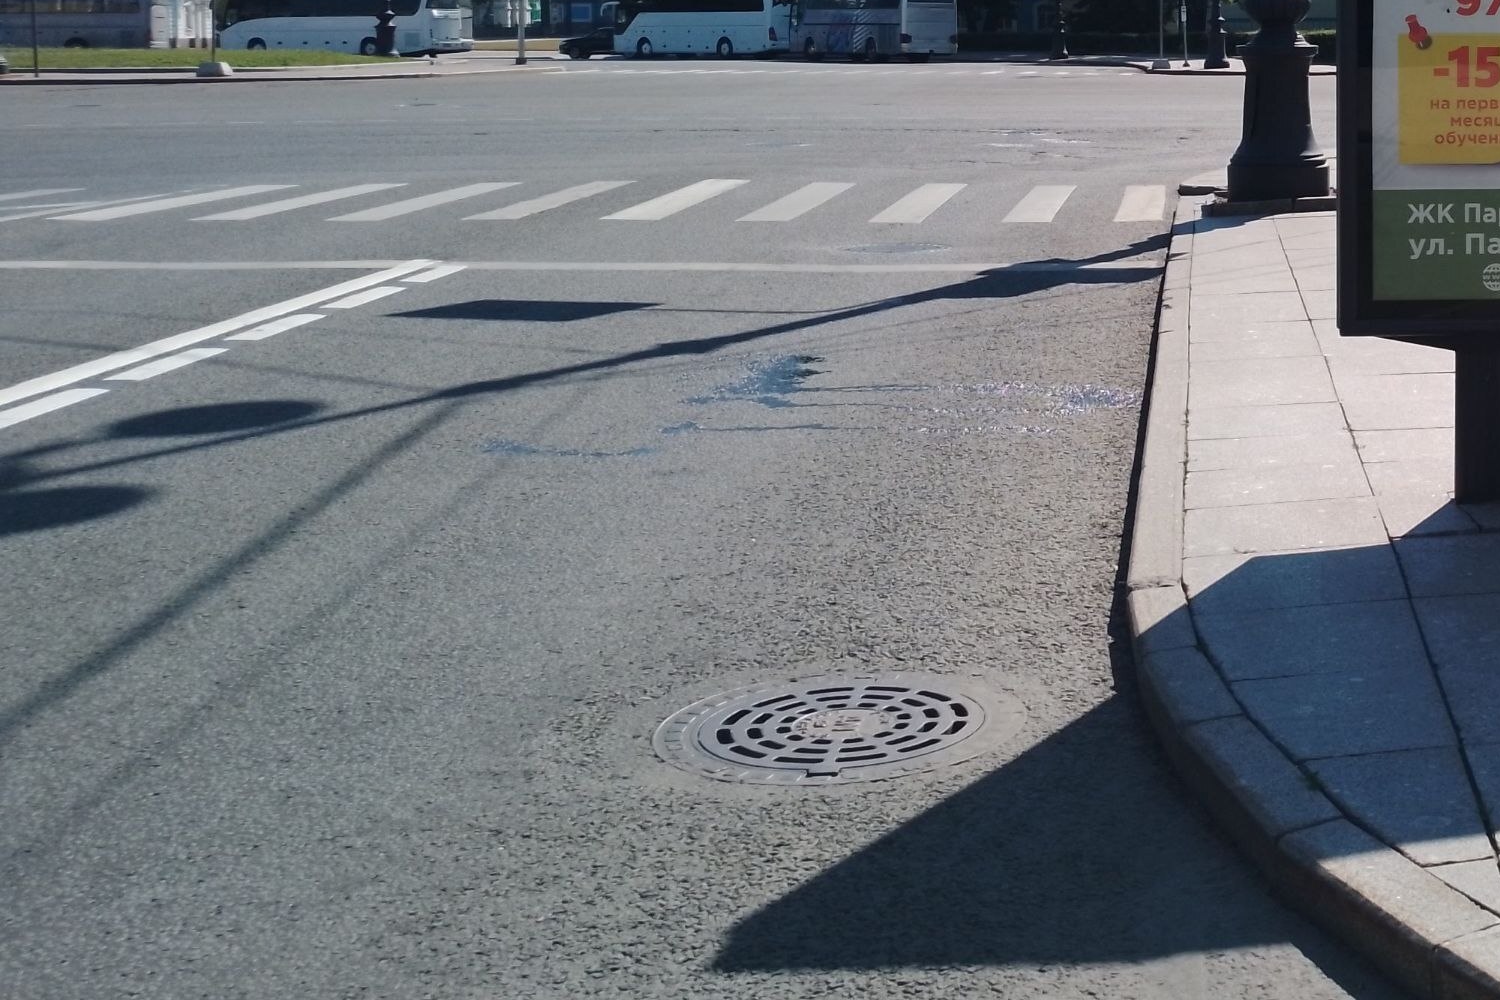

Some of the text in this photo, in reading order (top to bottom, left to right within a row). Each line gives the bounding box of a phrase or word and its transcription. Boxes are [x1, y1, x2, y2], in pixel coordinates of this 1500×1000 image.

[1429, 98, 1450, 111] на
[1407, 203, 1454, 224] ЖК
[1408, 235, 1454, 259] ул.
